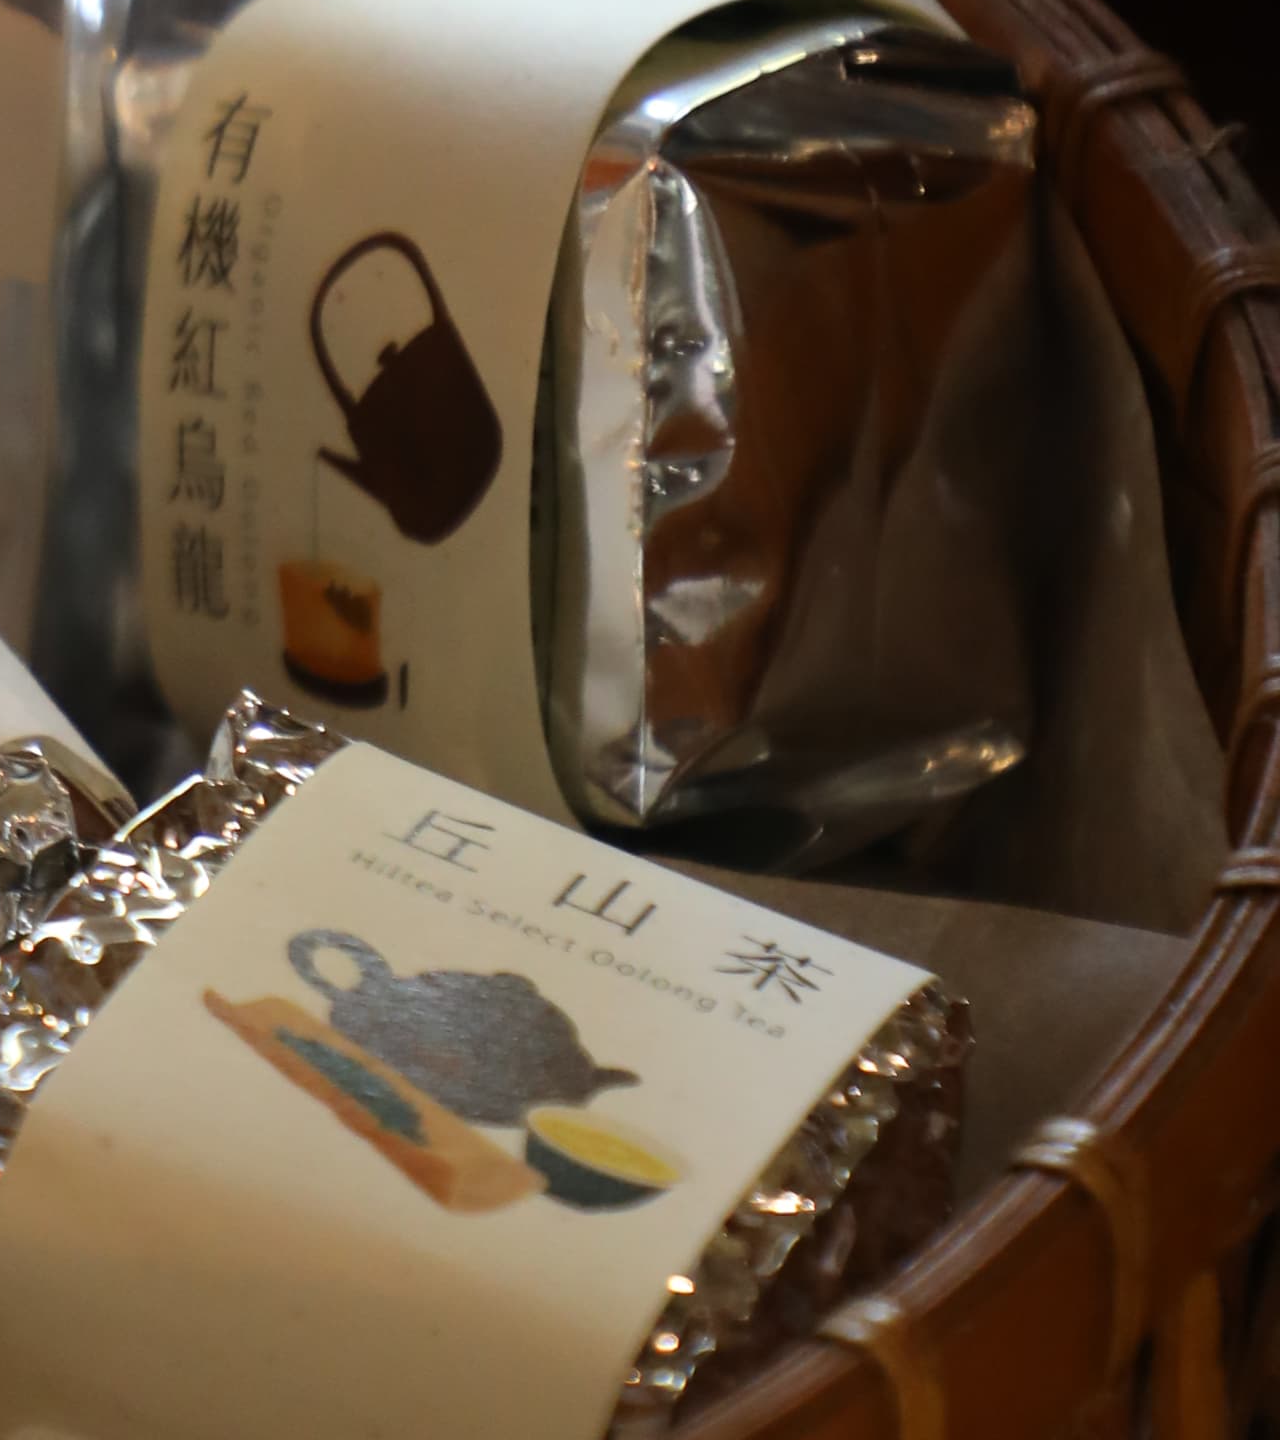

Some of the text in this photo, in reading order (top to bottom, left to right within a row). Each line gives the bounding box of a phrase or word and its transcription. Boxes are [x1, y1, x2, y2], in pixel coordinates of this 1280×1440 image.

[382, 810, 835, 1004] 丘山茶
[465, 897, 576, 953] Select
[589, 948, 719, 1014] Oolong
[732, 1001, 787, 1040] Tea
